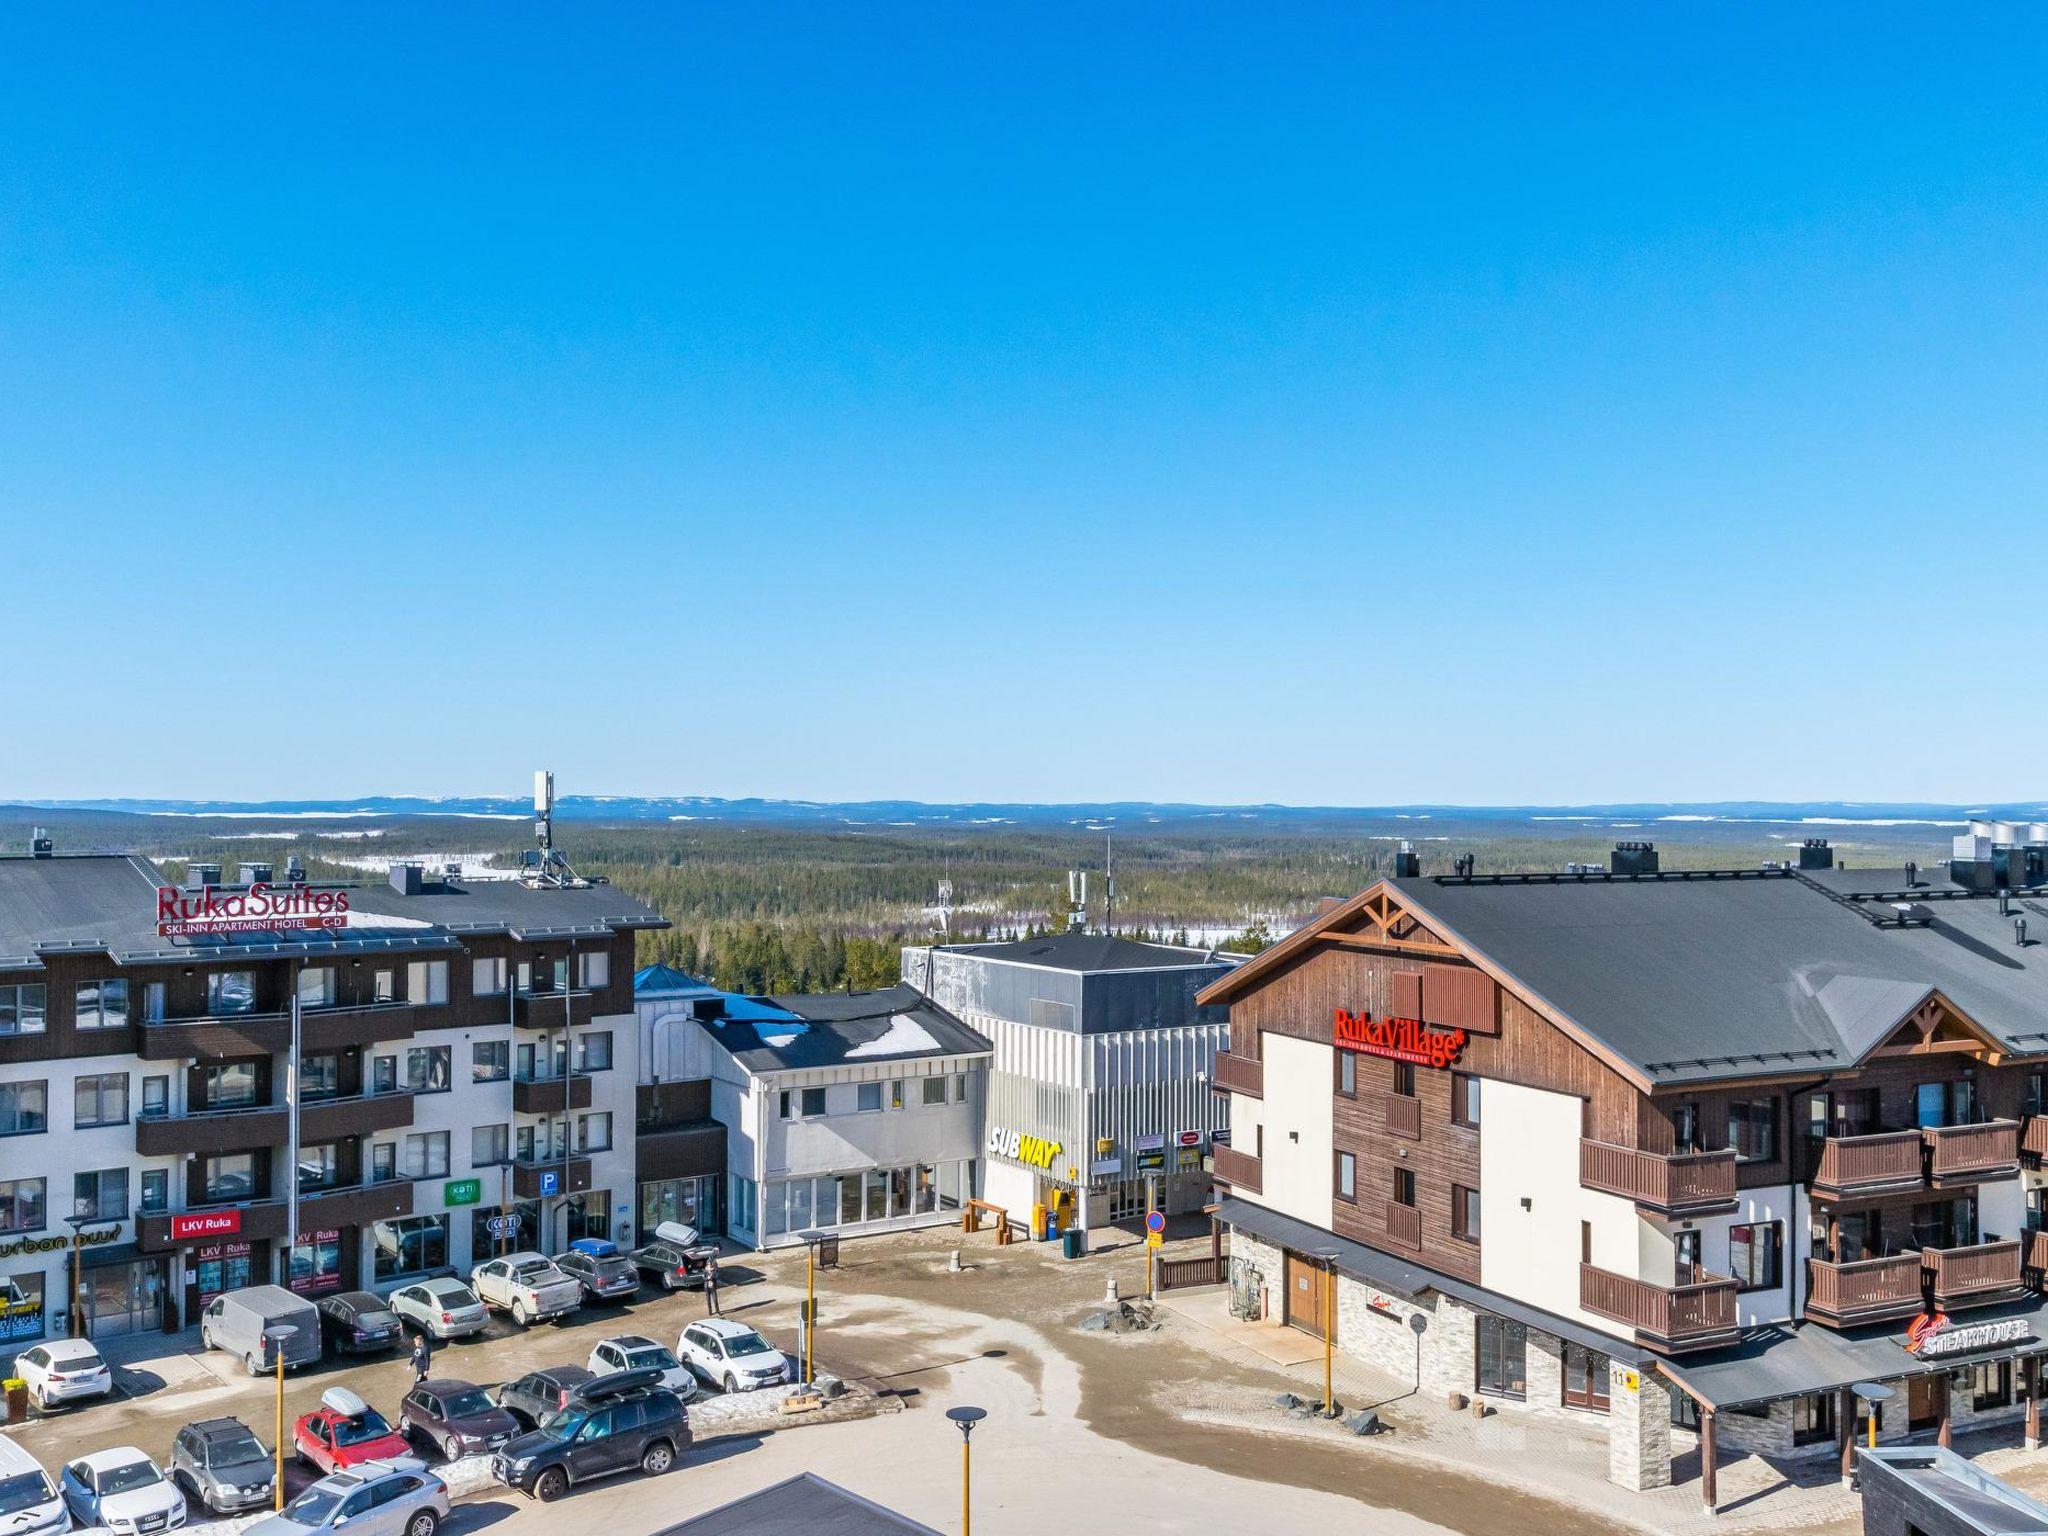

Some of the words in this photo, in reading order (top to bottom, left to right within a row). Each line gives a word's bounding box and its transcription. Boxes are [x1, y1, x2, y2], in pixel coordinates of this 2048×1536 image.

[157, 882, 350, 920] RukaSuites
[166, 923, 208, 935] SKI-INN
[211, 920, 271, 933] APARTMENT
[275, 918, 307, 929] HOTEL
[988, 1127, 1062, 1168] SUBWAY
[544, 1173, 554, 1189] P
[182, 1220, 203, 1232] LKV
[206, 1218, 231, 1229] Ruka
[316, 1229, 339, 1240] Ruka
[200, 1245, 220, 1257] LKV
[227, 1242, 251, 1253] Ruka
[1922, 1319, 2029, 1355] STEAKHOUSE
[1613, 1370, 1623, 1386] 11
